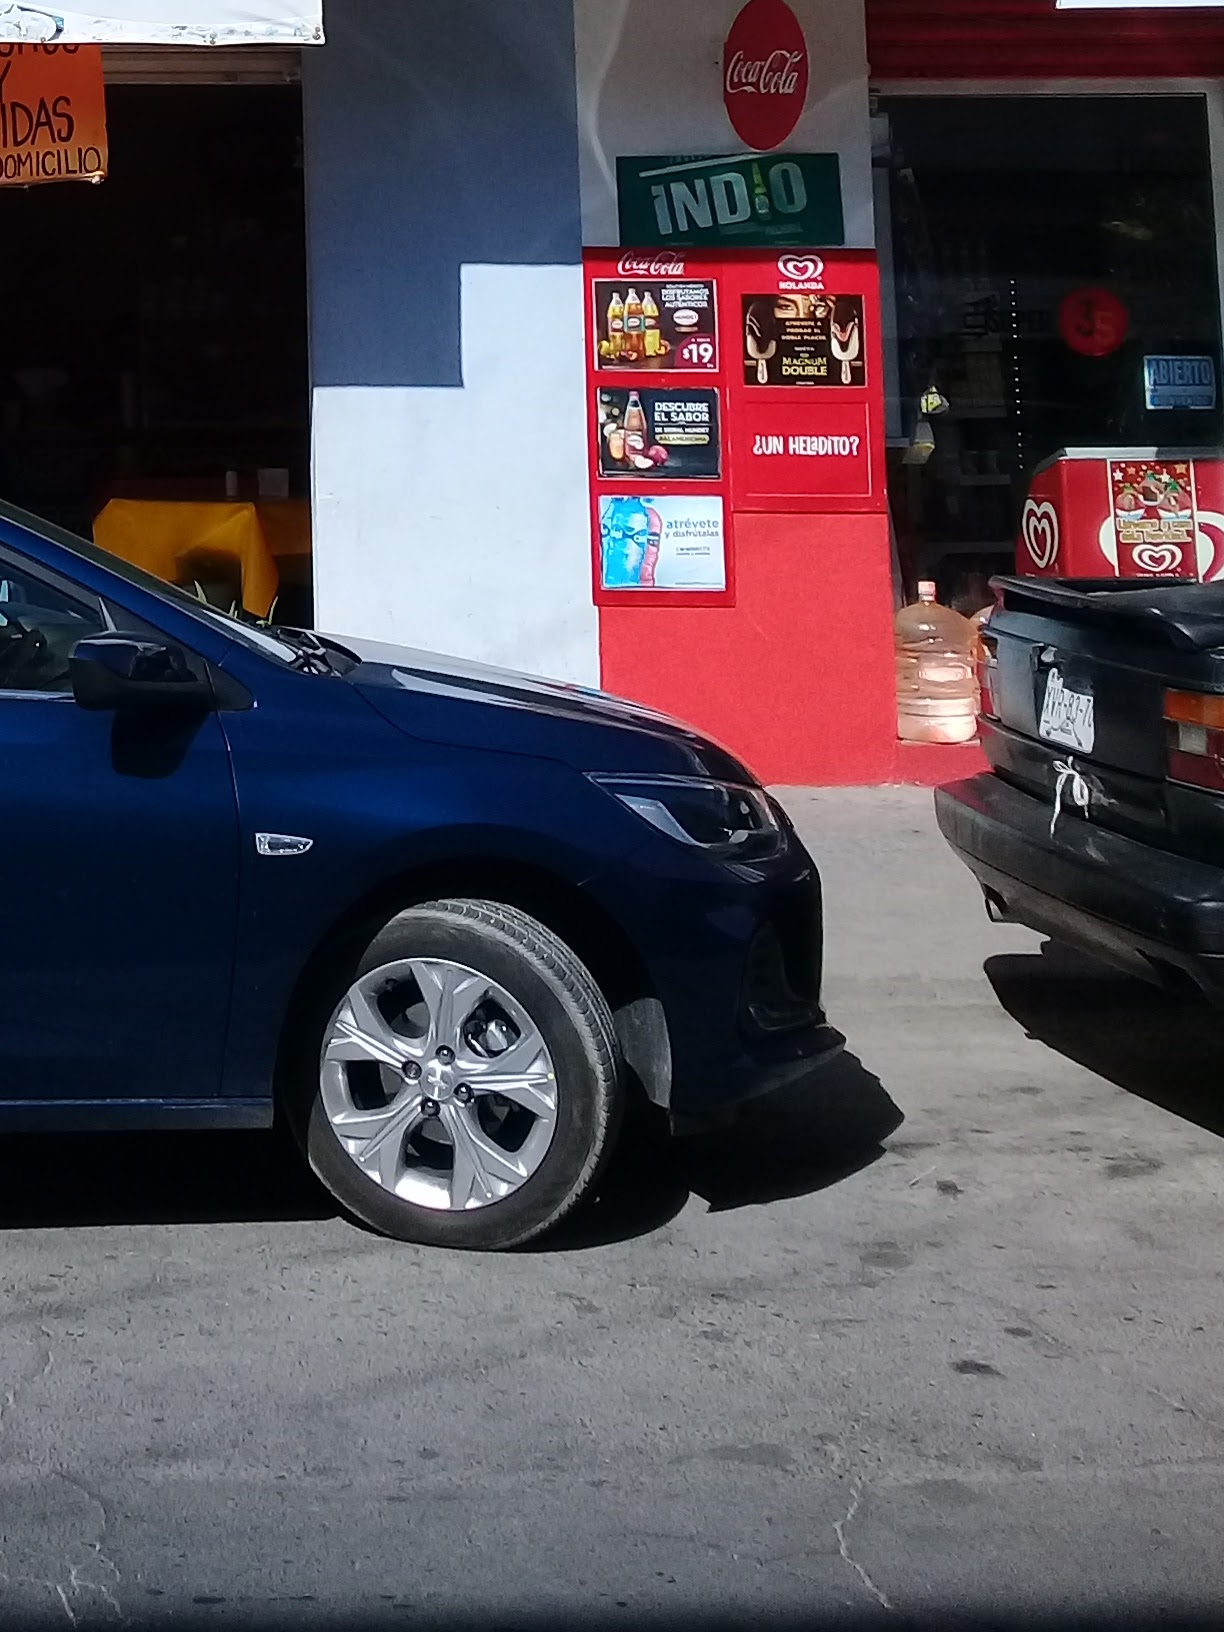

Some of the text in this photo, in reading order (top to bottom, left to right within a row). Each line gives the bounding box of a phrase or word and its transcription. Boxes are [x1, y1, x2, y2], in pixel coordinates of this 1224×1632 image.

[782, 356, 827, 366] MAGNUM
[782, 365, 828, 376] DOUBLE
[654, 402, 709, 412] DESCUBRE
[654, 412, 710, 422] EL SABOR
[753, 435, 784, 455] ¿UN
